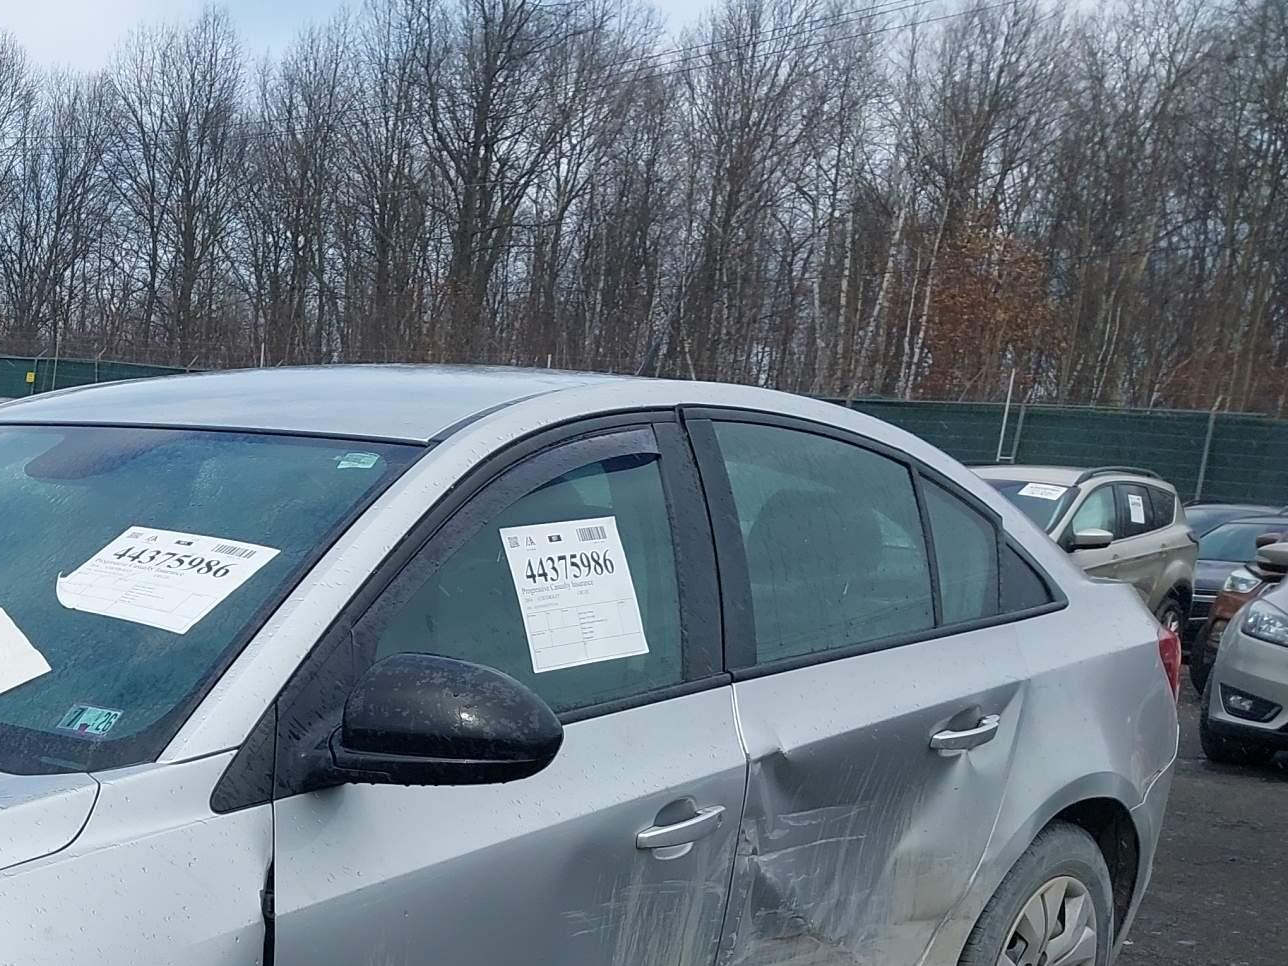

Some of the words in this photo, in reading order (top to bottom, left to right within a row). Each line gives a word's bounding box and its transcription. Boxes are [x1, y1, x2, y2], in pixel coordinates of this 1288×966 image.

[113, 545, 238, 579] 44375986
[524, 549, 615, 584] 44375986
[95, 711, 118, 732] 26
